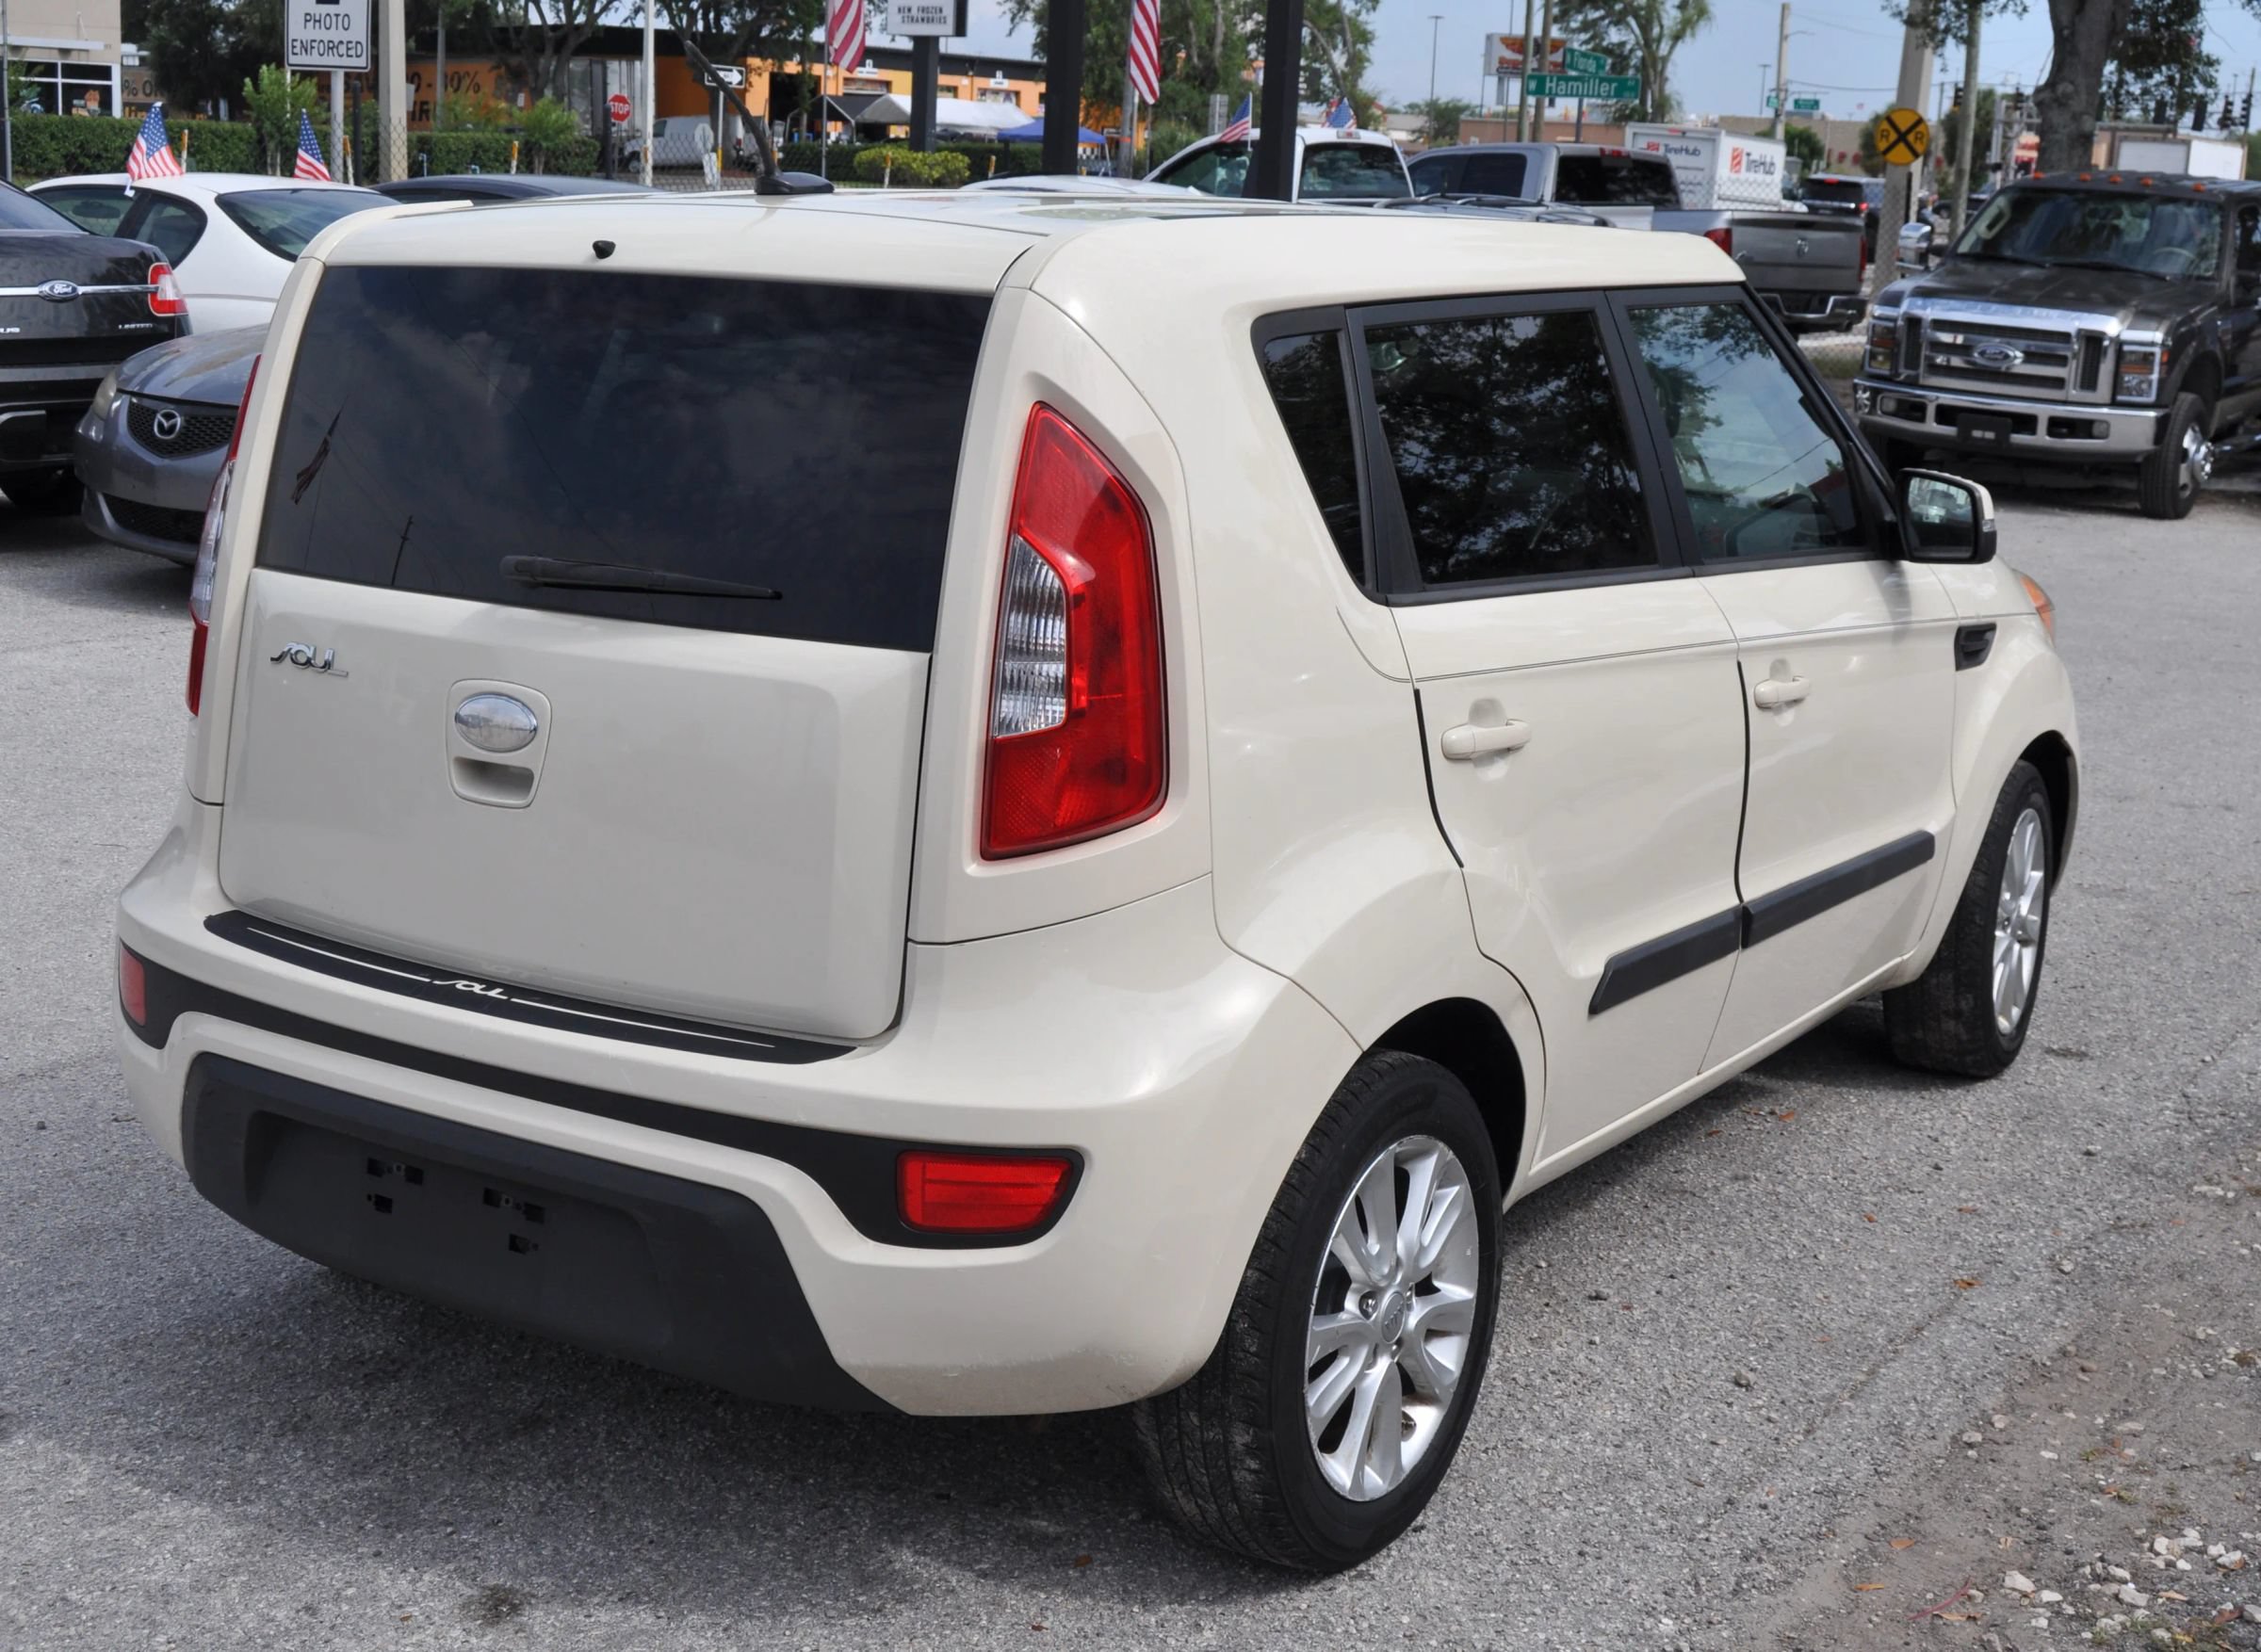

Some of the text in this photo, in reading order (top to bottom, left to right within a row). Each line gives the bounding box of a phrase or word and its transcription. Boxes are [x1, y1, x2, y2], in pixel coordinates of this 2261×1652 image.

[917, 6, 944, 15] FROZEN
[303, 12, 351, 31] PHOTO
[290, 39, 364, 58] ENFORCED
[1528, 78, 1537, 92] W
[1545, 76, 1618, 95] Hamiller
[610, 101, 629, 114] STOP
[1879, 128, 1925, 146] R R
[1663, 143, 1701, 157] TireHub
[1745, 152, 1777, 176] TireHub
[53, 283, 73, 296] Ford
